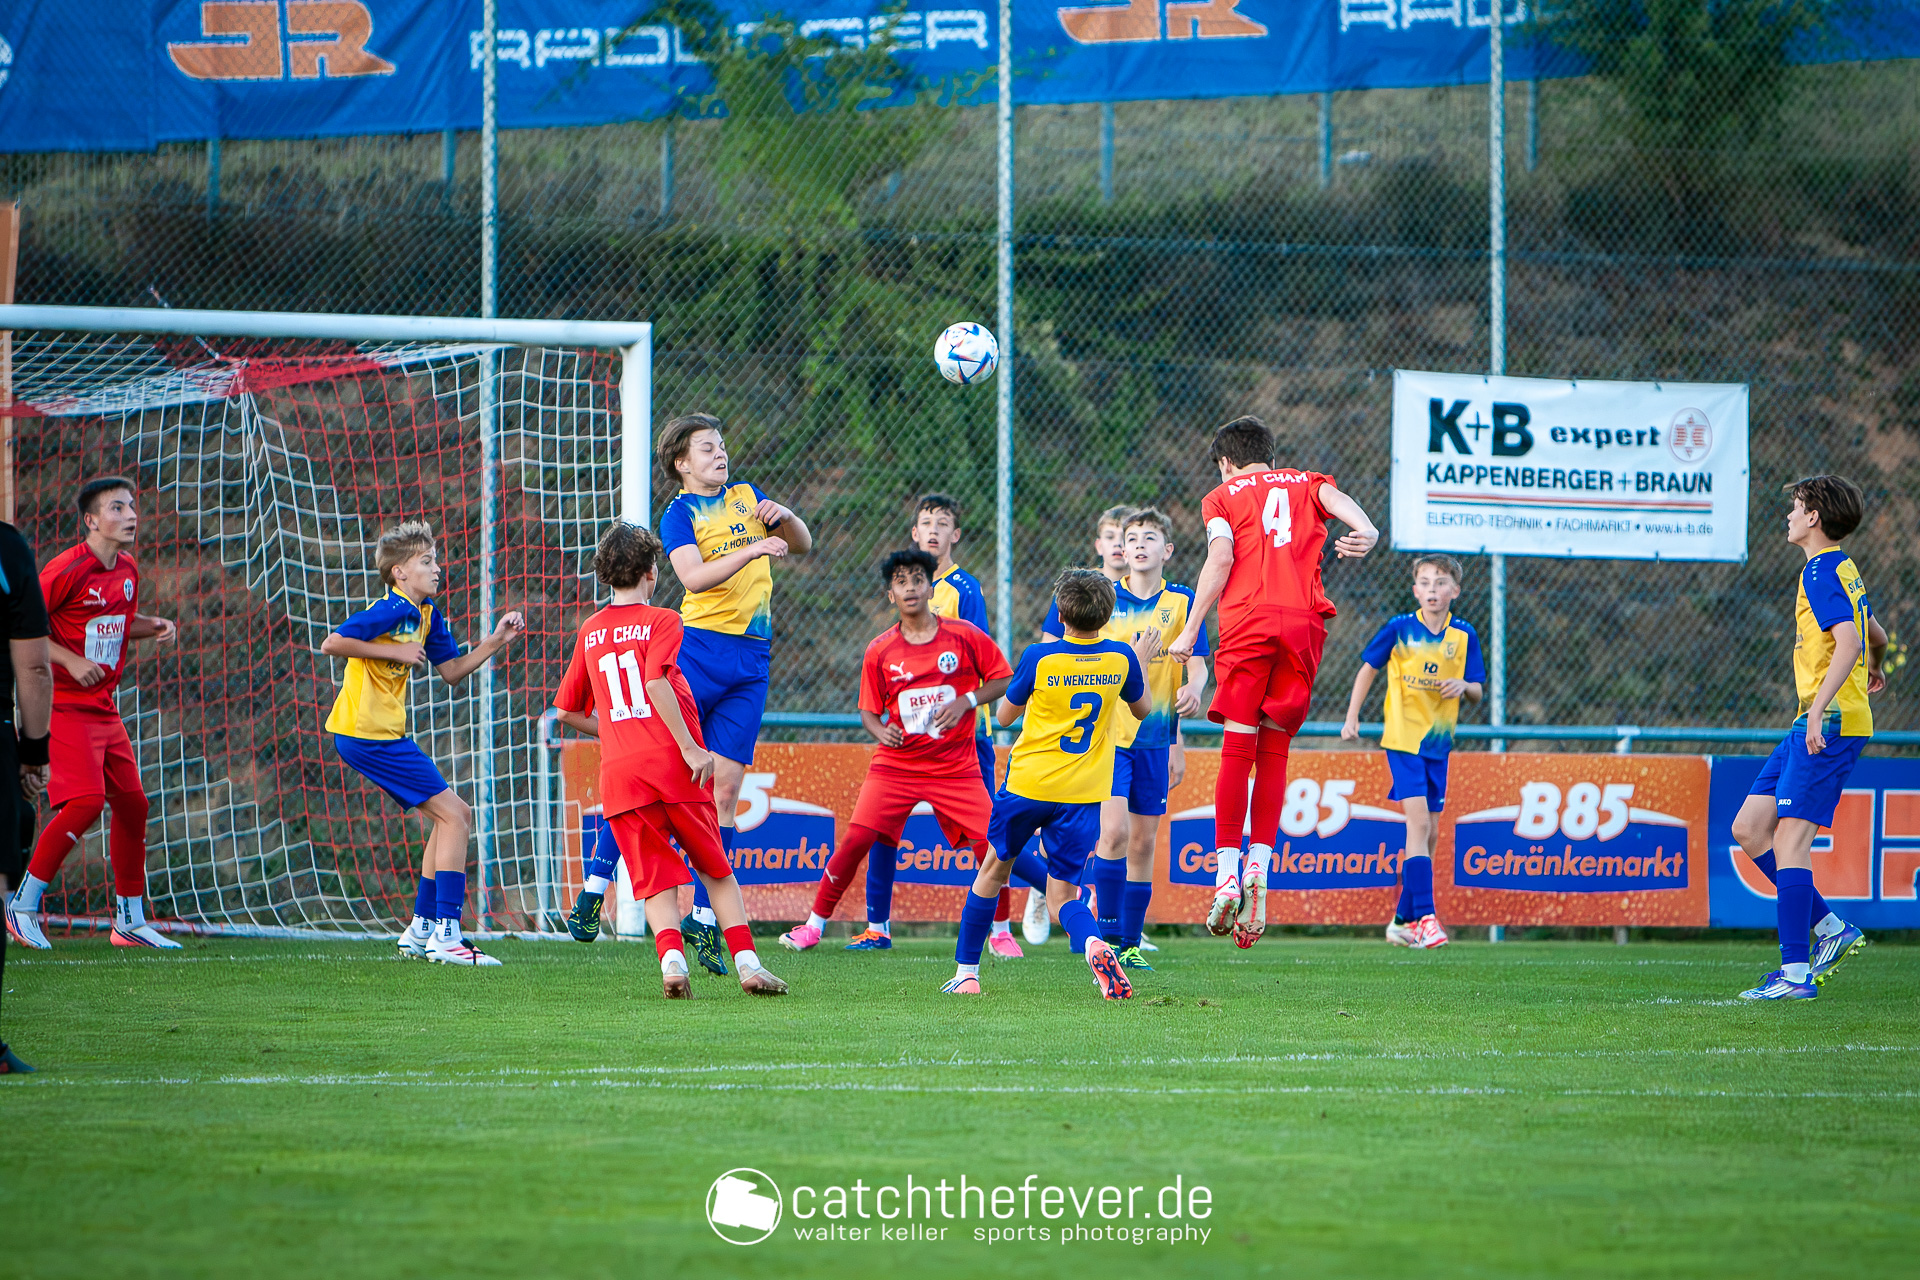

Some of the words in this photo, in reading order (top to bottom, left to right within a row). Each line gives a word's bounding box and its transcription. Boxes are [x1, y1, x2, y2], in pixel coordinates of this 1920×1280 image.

[1428, 397, 1534, 457] K+B
[1550, 424, 1661, 449] expert
[1227, 474, 1257, 496] ASV
[1262, 472, 1309, 484] CHAM
[1261, 486, 1292, 548] 4
[1555, 517, 1632, 534] FACHMARKT
[585, 628, 608, 653] ASV
[613, 624, 652, 643] CHAM
[598, 649, 653, 722] 11
[1047, 674, 1061, 687] SV
[909, 692, 945, 707] REWE
[1059, 692, 1103, 754] 3
[1513, 781, 1635, 841] B85
[1178, 841, 1406, 875] Genkemarkt
[1463, 844, 1684, 877] Getränkemarkt
